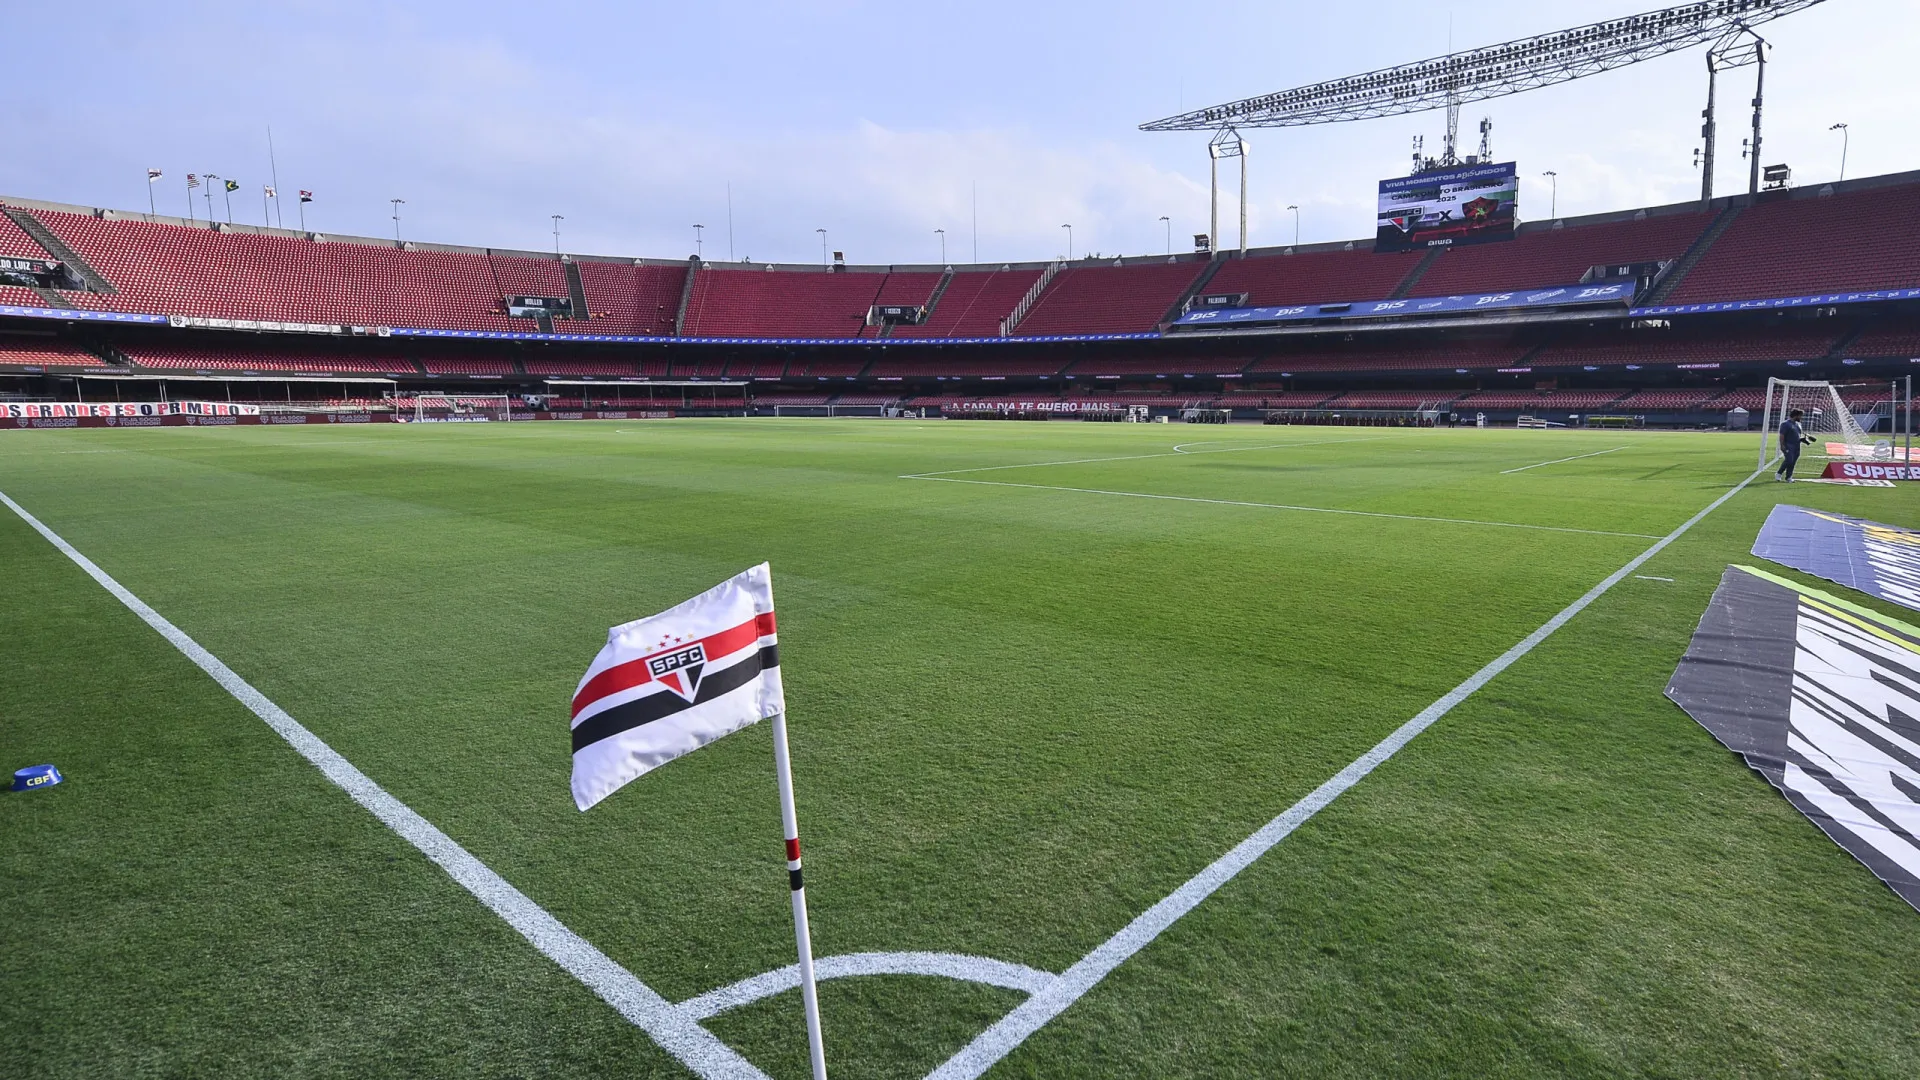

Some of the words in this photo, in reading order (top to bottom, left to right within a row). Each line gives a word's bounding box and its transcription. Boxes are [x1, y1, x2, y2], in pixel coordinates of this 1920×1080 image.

[1406, 174, 1455, 185] MOMENTOS
[1436, 195, 1456, 203] 2025
[13, 261, 31, 271] LUIZ
[26, 404, 110, 417] GRANDES
[140, 404, 152, 416] O
[157, 401, 239, 416] PRIMEIRO
[653, 648, 702, 674] SPFC
[26, 774, 50, 787] CBF
